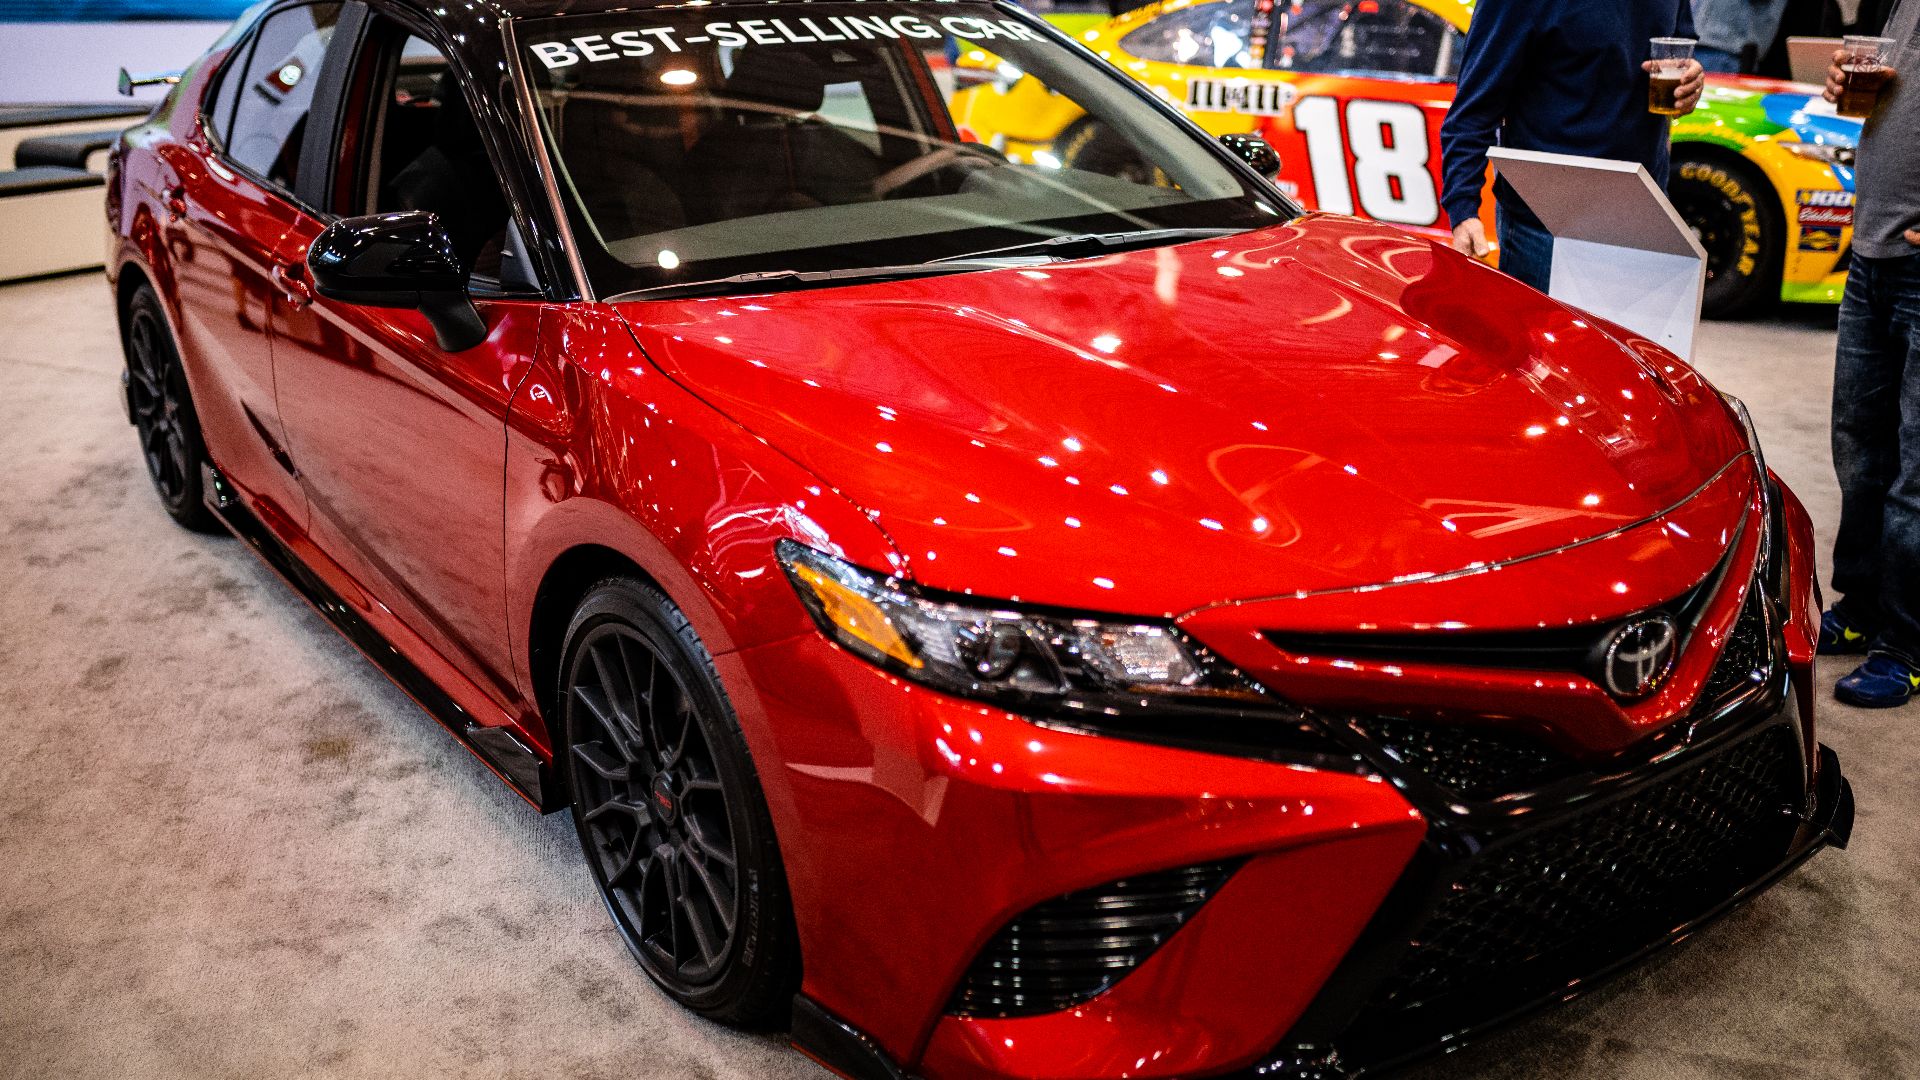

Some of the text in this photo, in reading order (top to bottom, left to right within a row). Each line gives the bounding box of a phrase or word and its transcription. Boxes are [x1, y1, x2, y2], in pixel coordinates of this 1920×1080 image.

[529, 15, 1049, 70] BEST-SELLING CAR
[1293, 95, 1439, 225] 18
